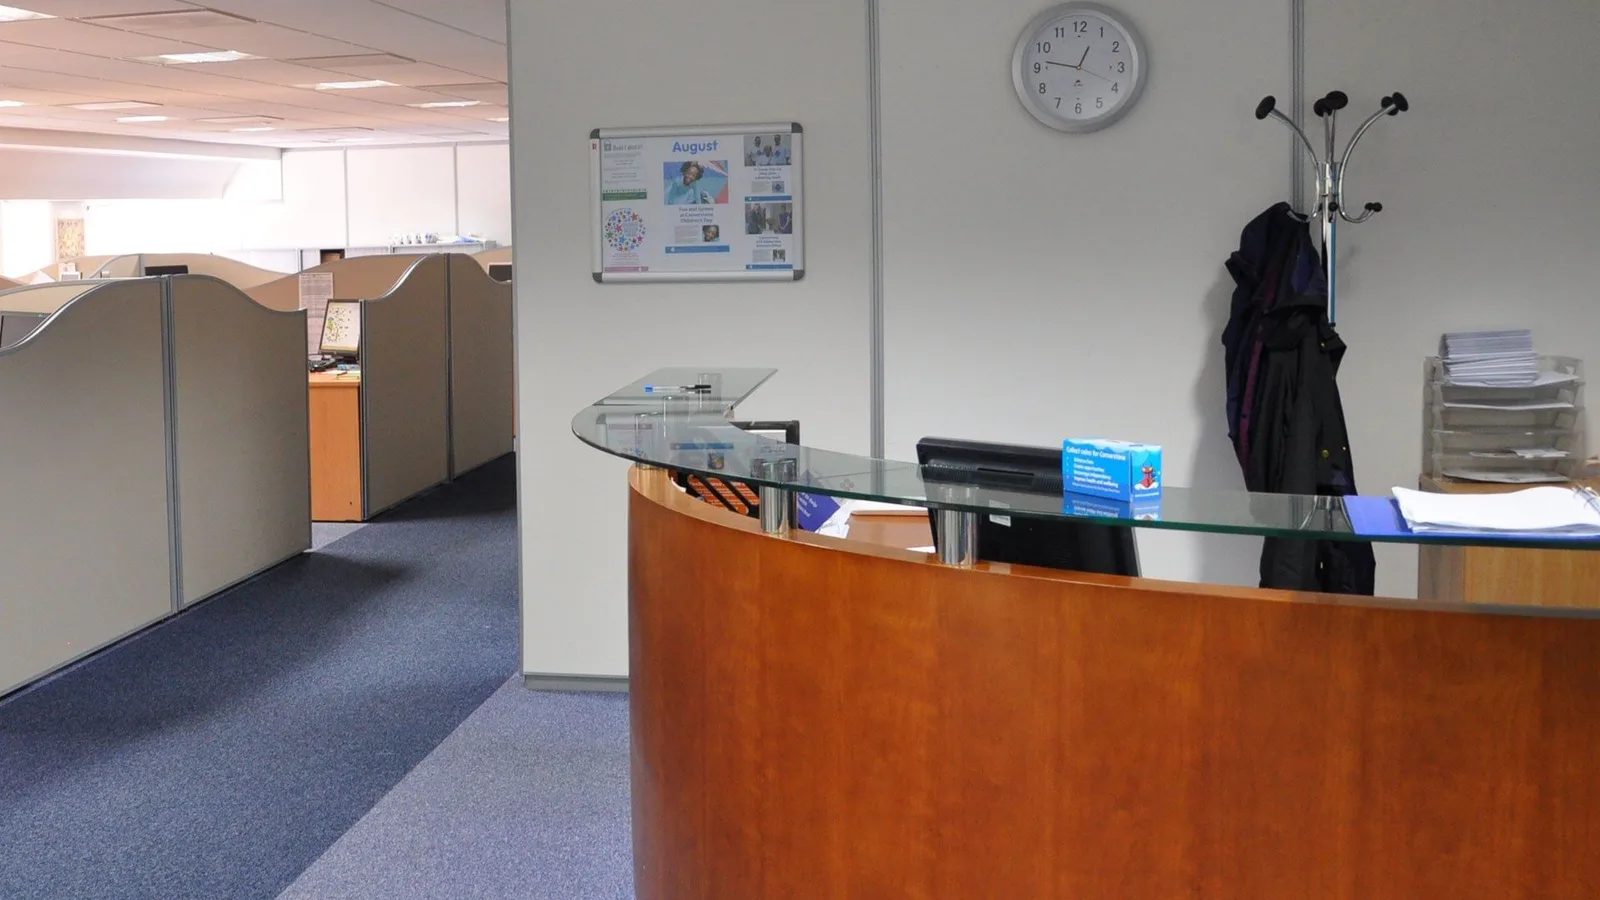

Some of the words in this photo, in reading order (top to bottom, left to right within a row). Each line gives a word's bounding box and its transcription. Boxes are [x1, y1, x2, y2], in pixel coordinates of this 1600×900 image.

[1055, 27, 1065, 38] 11
[1073, 21, 1087, 32] 12
[1099, 26, 1104, 38] 1
[1037, 42, 1051, 53] 10
[1112, 41, 1120, 52] 2
[1033, 62, 1041, 74] 9
[1118, 62, 1125, 73] 3
[1038, 82, 1046, 94] 8
[1111, 82, 1118, 94] 4
[1054, 97, 1062, 109] 7
[1074, 102, 1082, 114] 6
[1096, 97, 1103, 109] 5
[672, 140, 719, 154] August
[1066, 446, 1080, 454] Collect
[1099, 450, 1126, 460] Cornerstone
